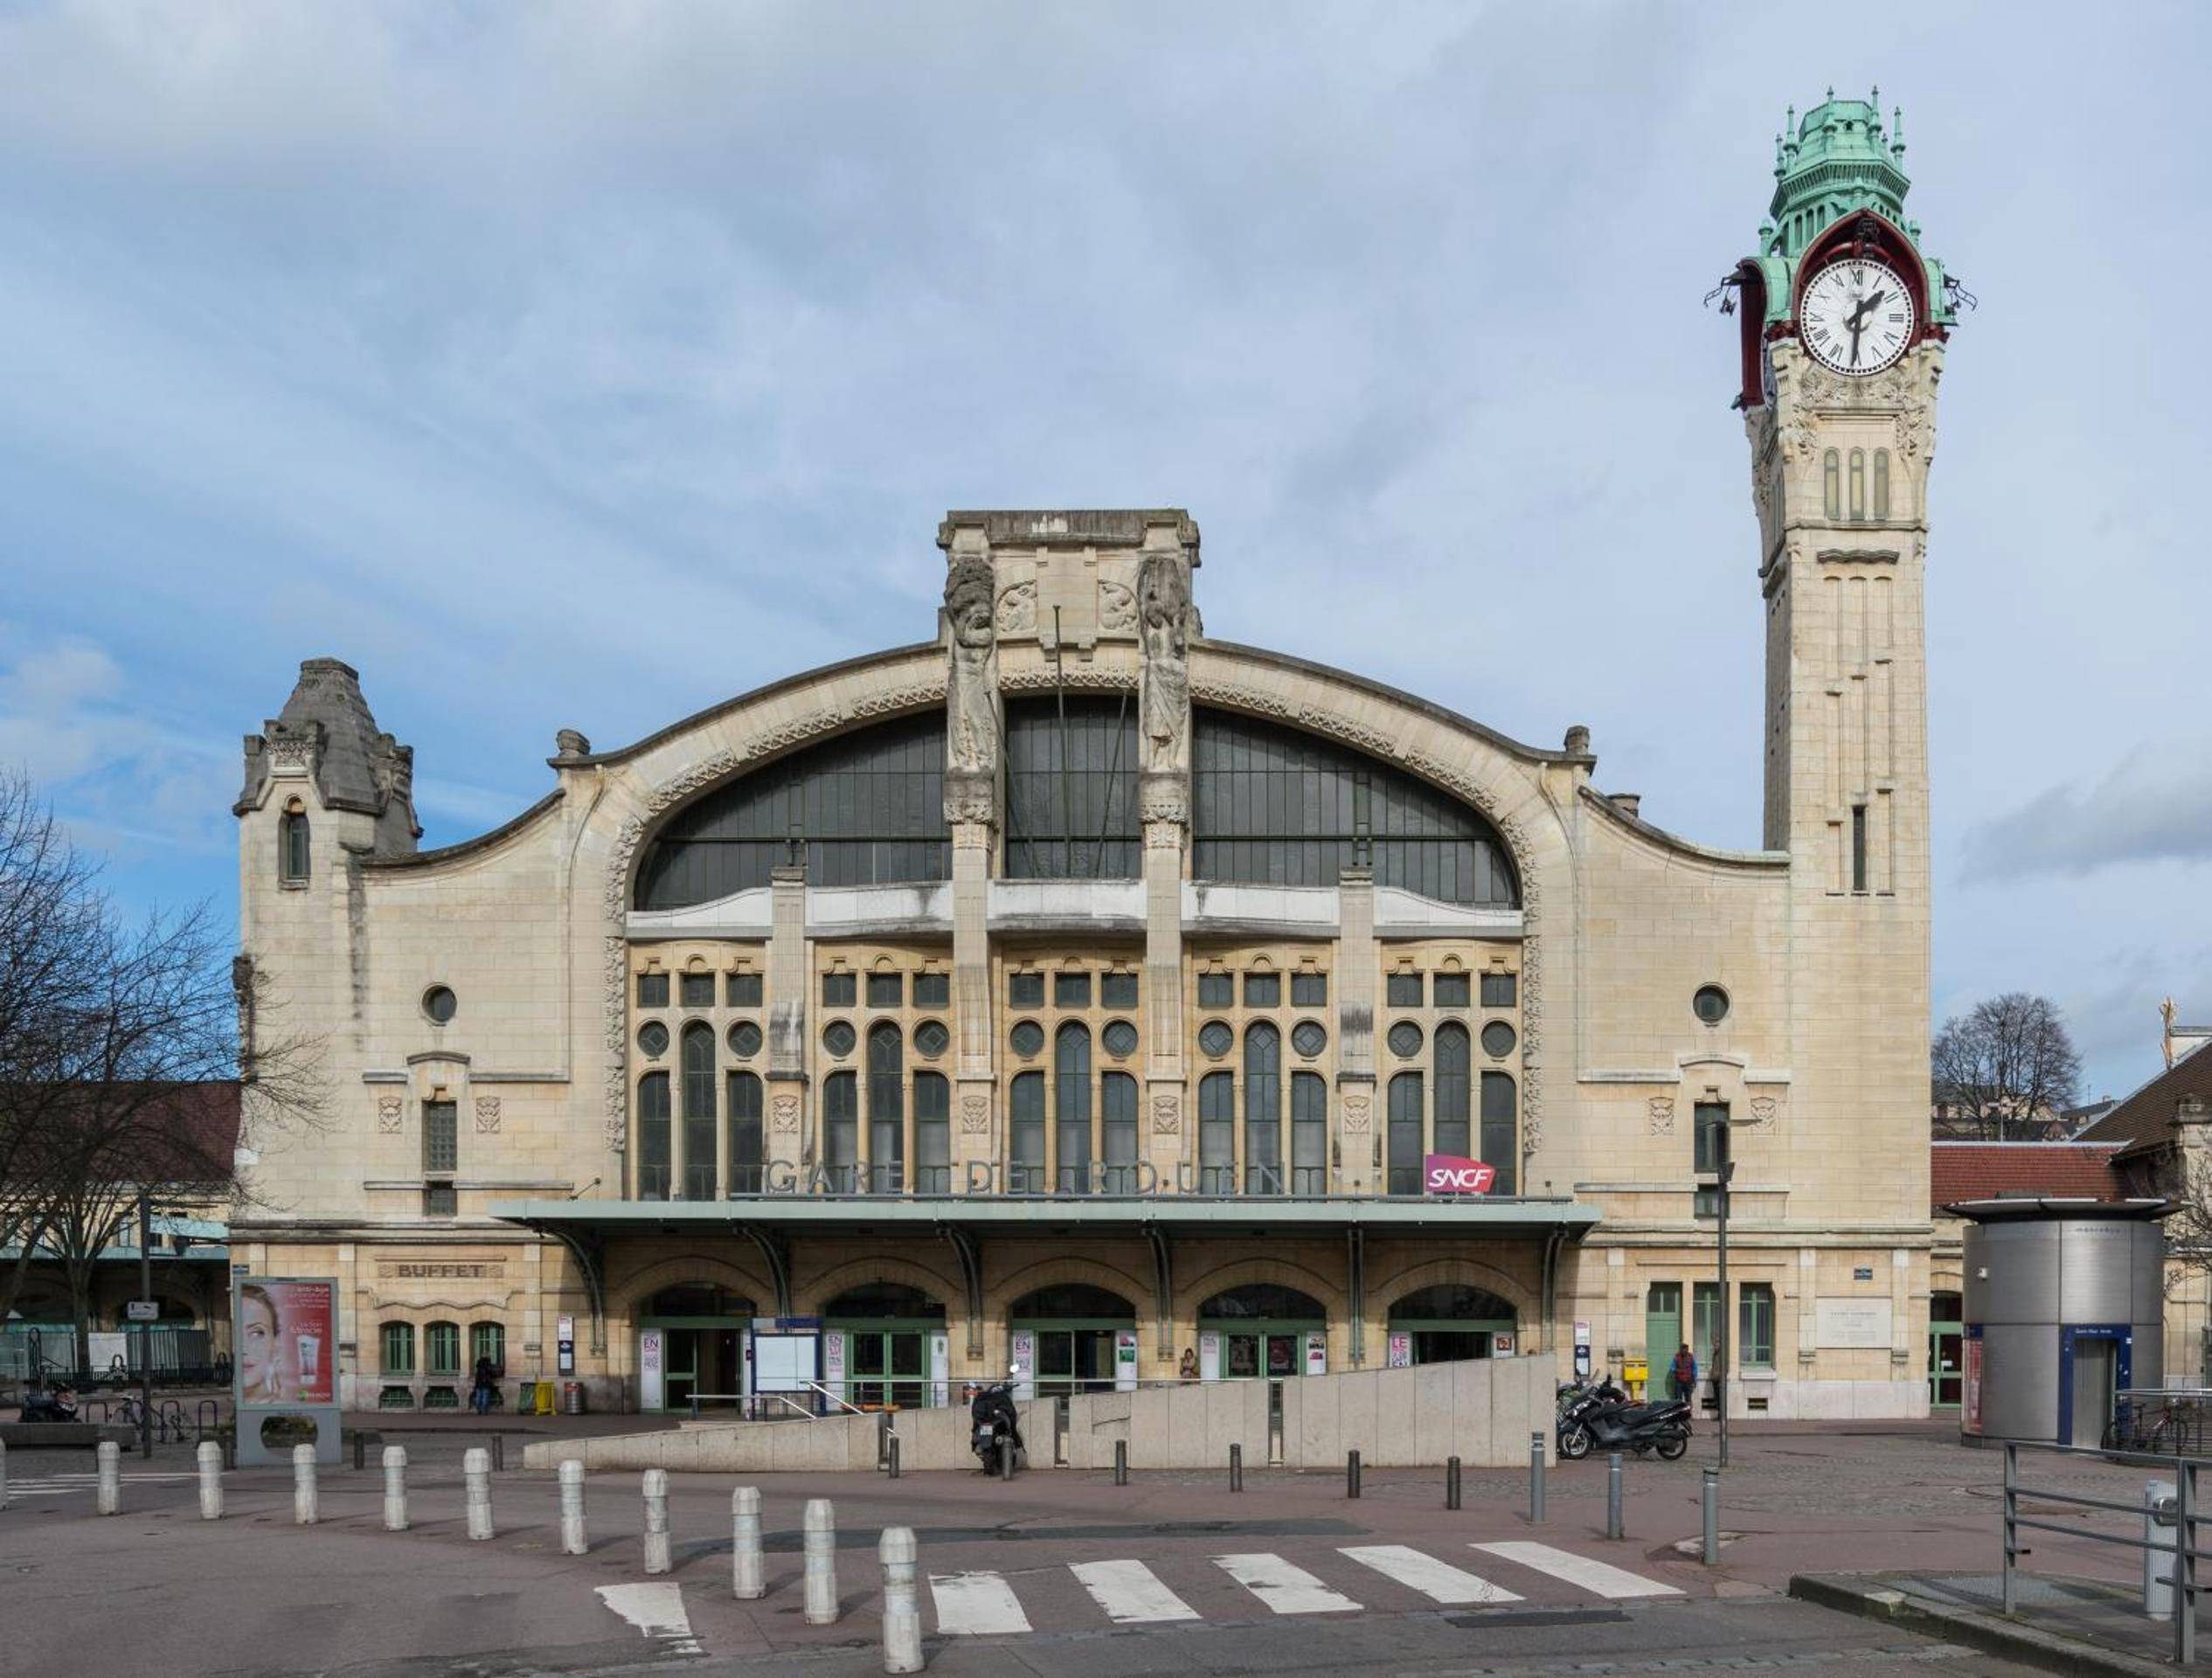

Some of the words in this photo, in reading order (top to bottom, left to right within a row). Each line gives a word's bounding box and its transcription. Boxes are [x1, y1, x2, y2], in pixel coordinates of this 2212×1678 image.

[766, 1159, 904, 1193] GARE
[967, 1160, 1023, 1192] DE
[1088, 1160, 1286, 1193] ROUEN
[1428, 1168, 1492, 1188] SNCF
[398, 1264, 485, 1278] BUFFET
